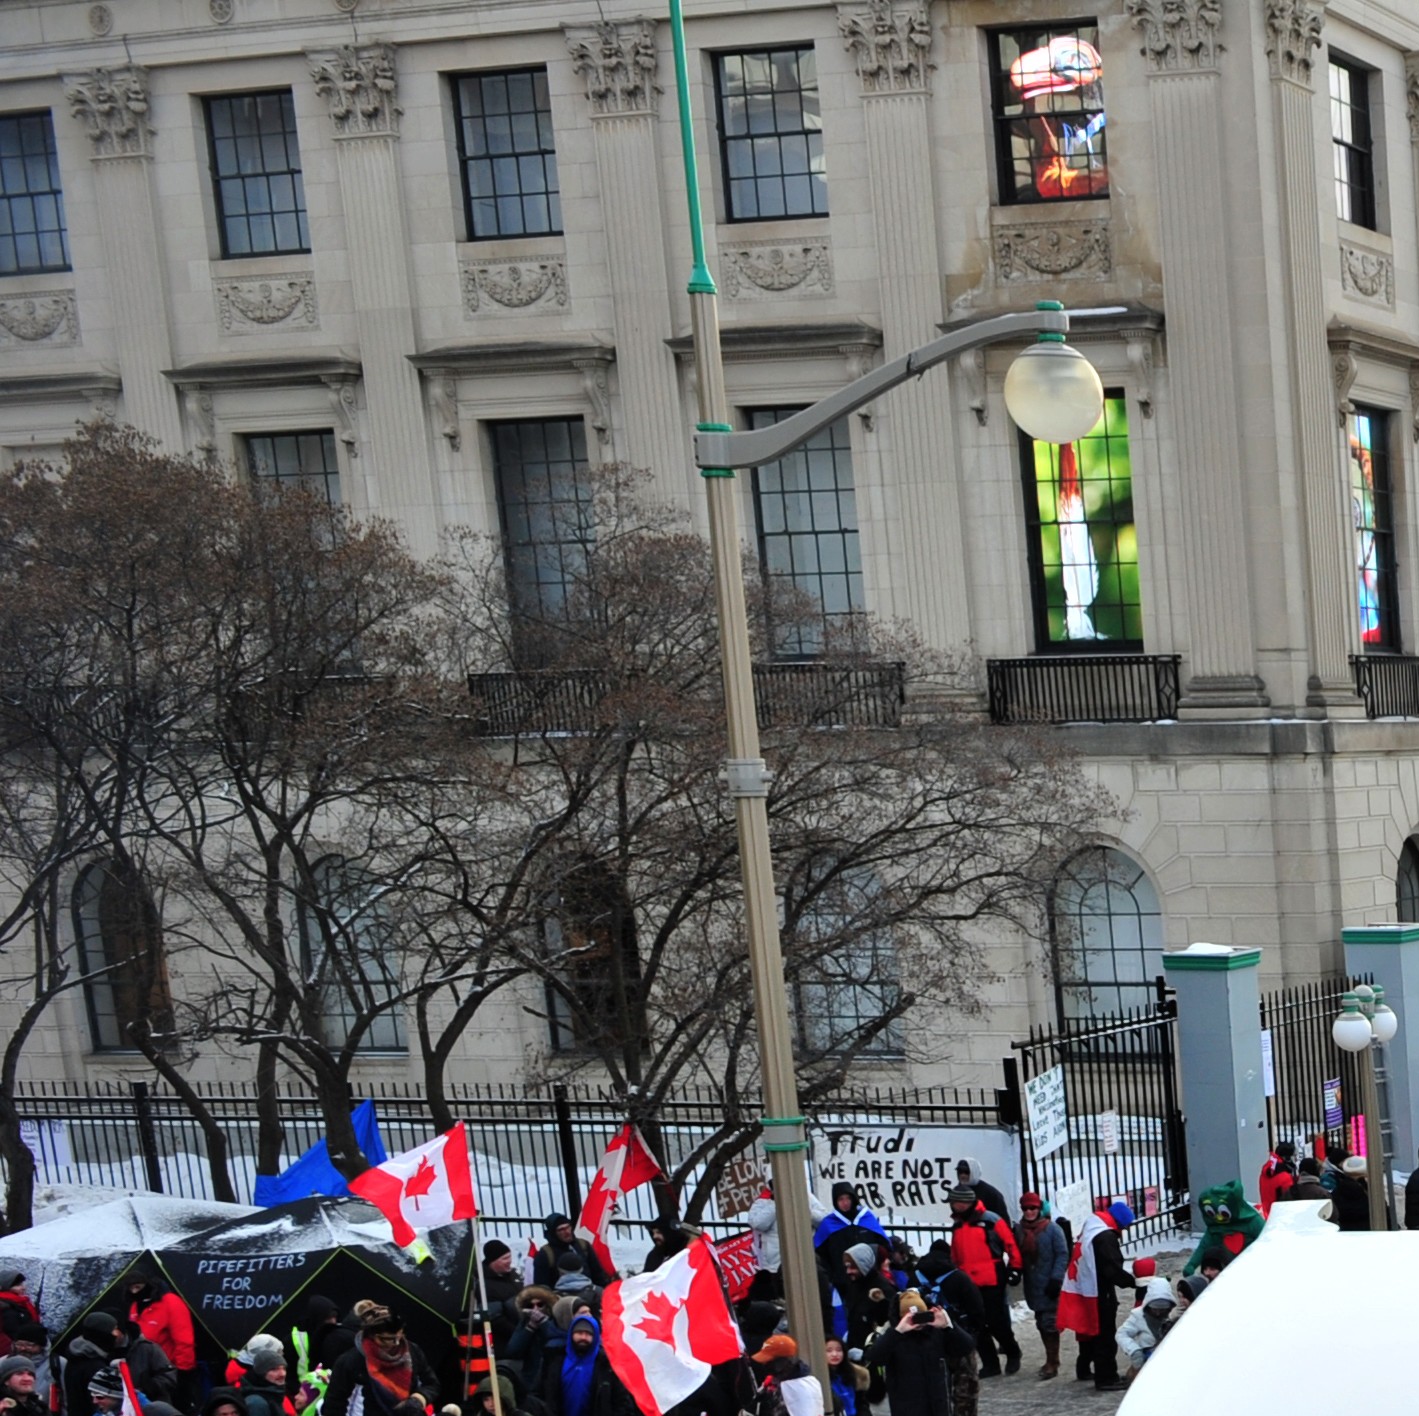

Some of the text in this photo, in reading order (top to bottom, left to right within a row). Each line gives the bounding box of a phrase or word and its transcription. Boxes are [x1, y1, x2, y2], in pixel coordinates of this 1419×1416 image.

[827, 1128, 915, 1155] Trudi
[818, 1157, 952, 1180] WE ARE NOT
[892, 1180, 952, 1207] RATS
[197, 1252, 306, 1275] PIPEFITTERS
[222, 1276, 252, 1291] FOR
[202, 1294, 284, 1310] FREEDOM
